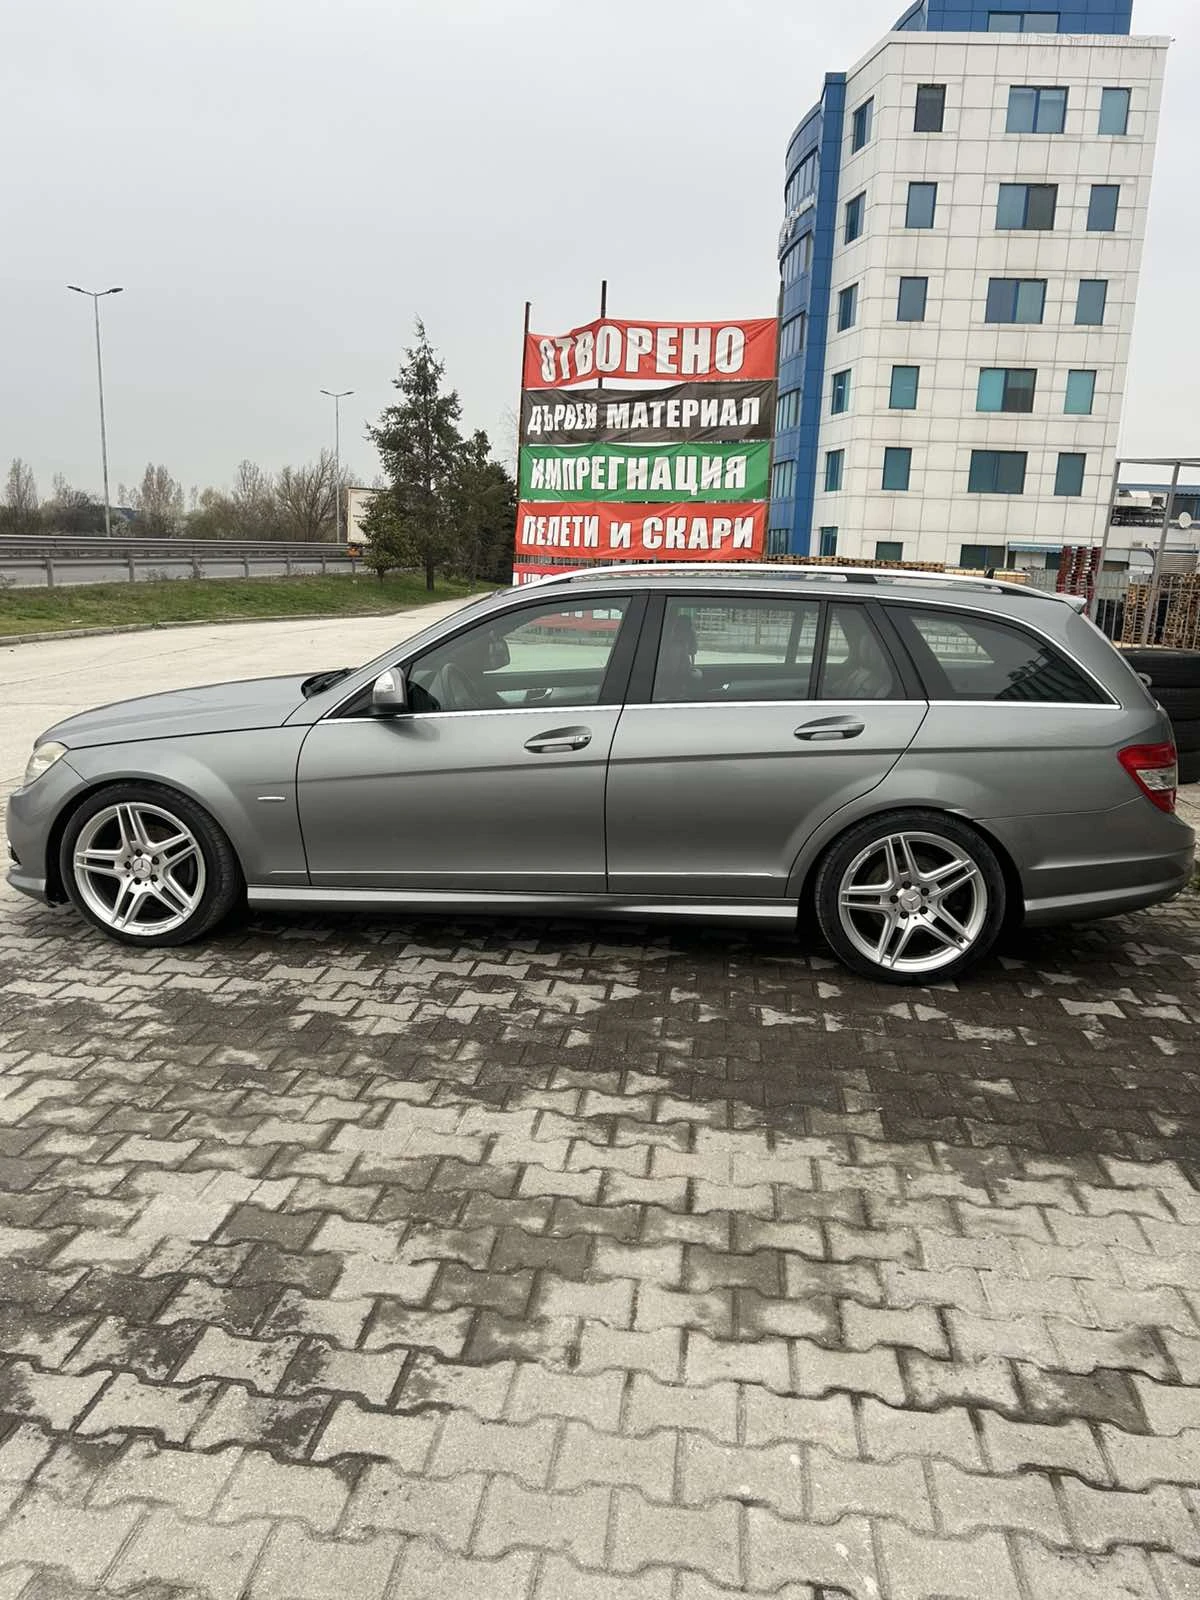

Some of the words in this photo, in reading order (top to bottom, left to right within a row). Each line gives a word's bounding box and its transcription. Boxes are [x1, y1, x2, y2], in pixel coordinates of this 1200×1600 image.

[539, 325, 746, 382] ОТВОРЕНО
[527, 403, 598, 435] ДЪРВЕН
[606, 397, 760, 429] МАТЕРИАЛ
[530, 455, 747, 496] ИМПРЕГНАЦИЯ
[521, 515, 600, 548] ПЕЛЕТИ
[642, 515, 755, 550] СКАРИ
